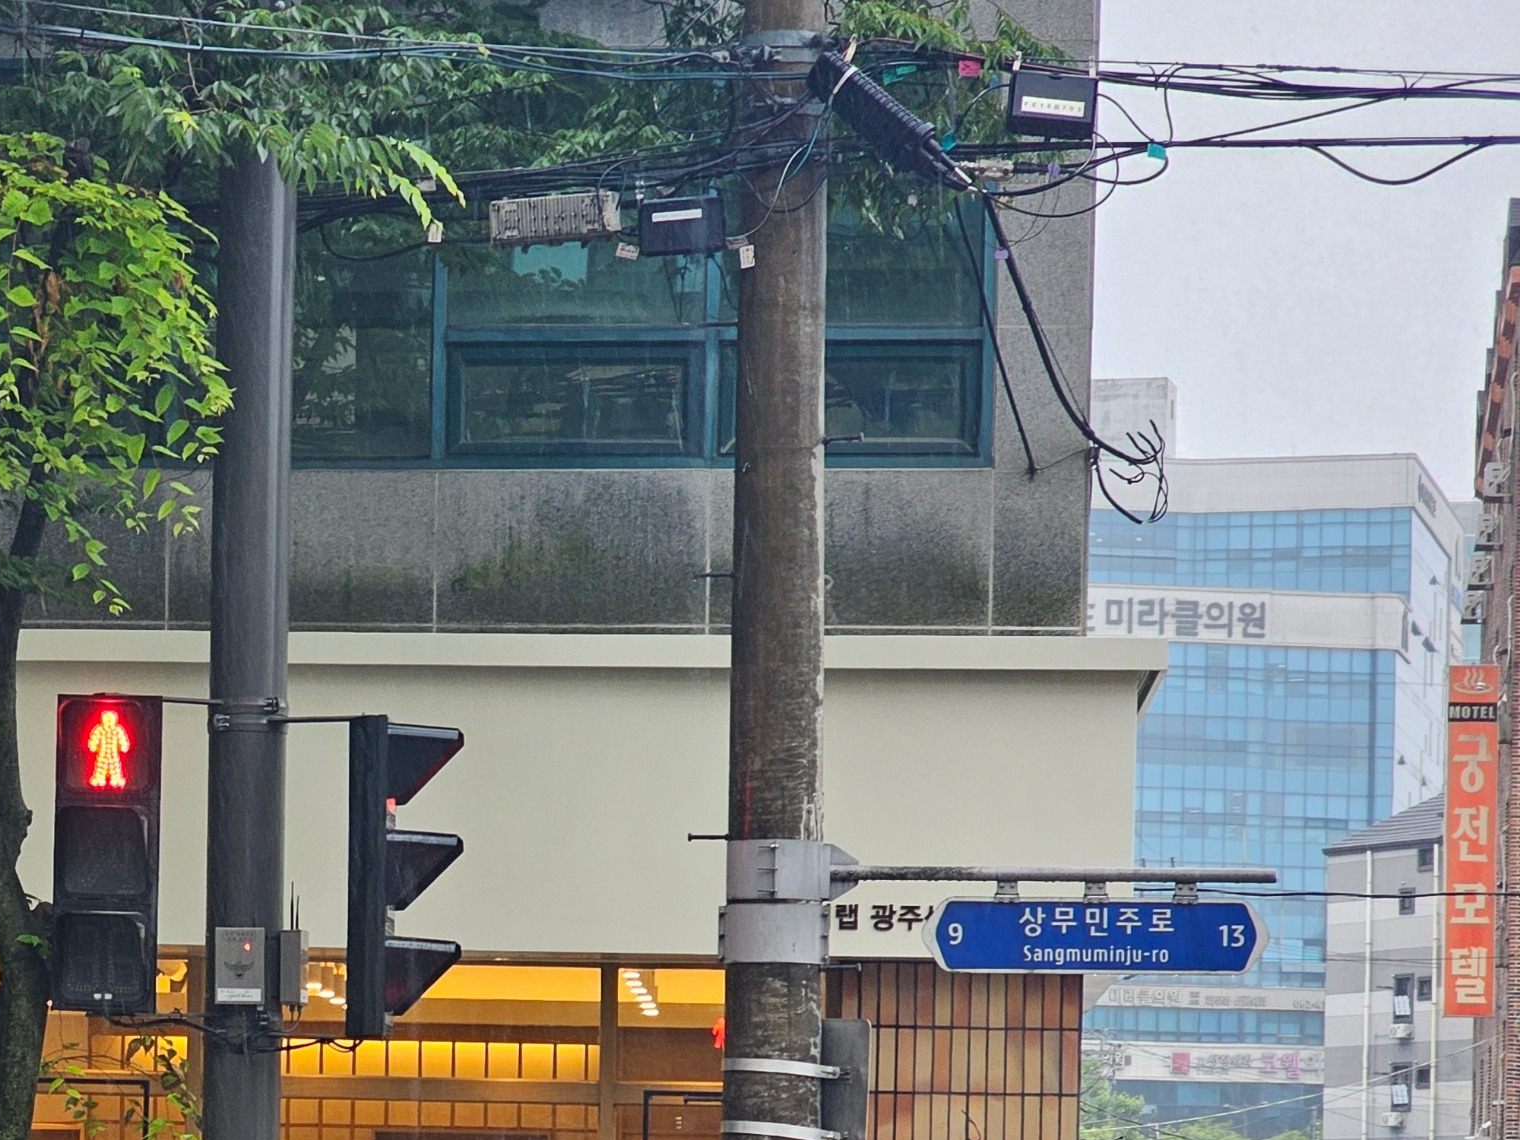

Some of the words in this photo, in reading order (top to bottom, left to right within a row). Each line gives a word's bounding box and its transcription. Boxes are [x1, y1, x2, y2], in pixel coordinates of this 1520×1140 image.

[1106, 597, 1266, 638] 미라클의원
[1449, 704, 1497, 720] MOTEL
[1449, 733, 1495, 1005] 궁전모텔
[1018, 908, 1176, 937] 상무민주로
[947, 923, 964, 946] 9
[1218, 925, 1246, 948] 13
[1023, 945, 1170, 964] Sangmuminju-ro
